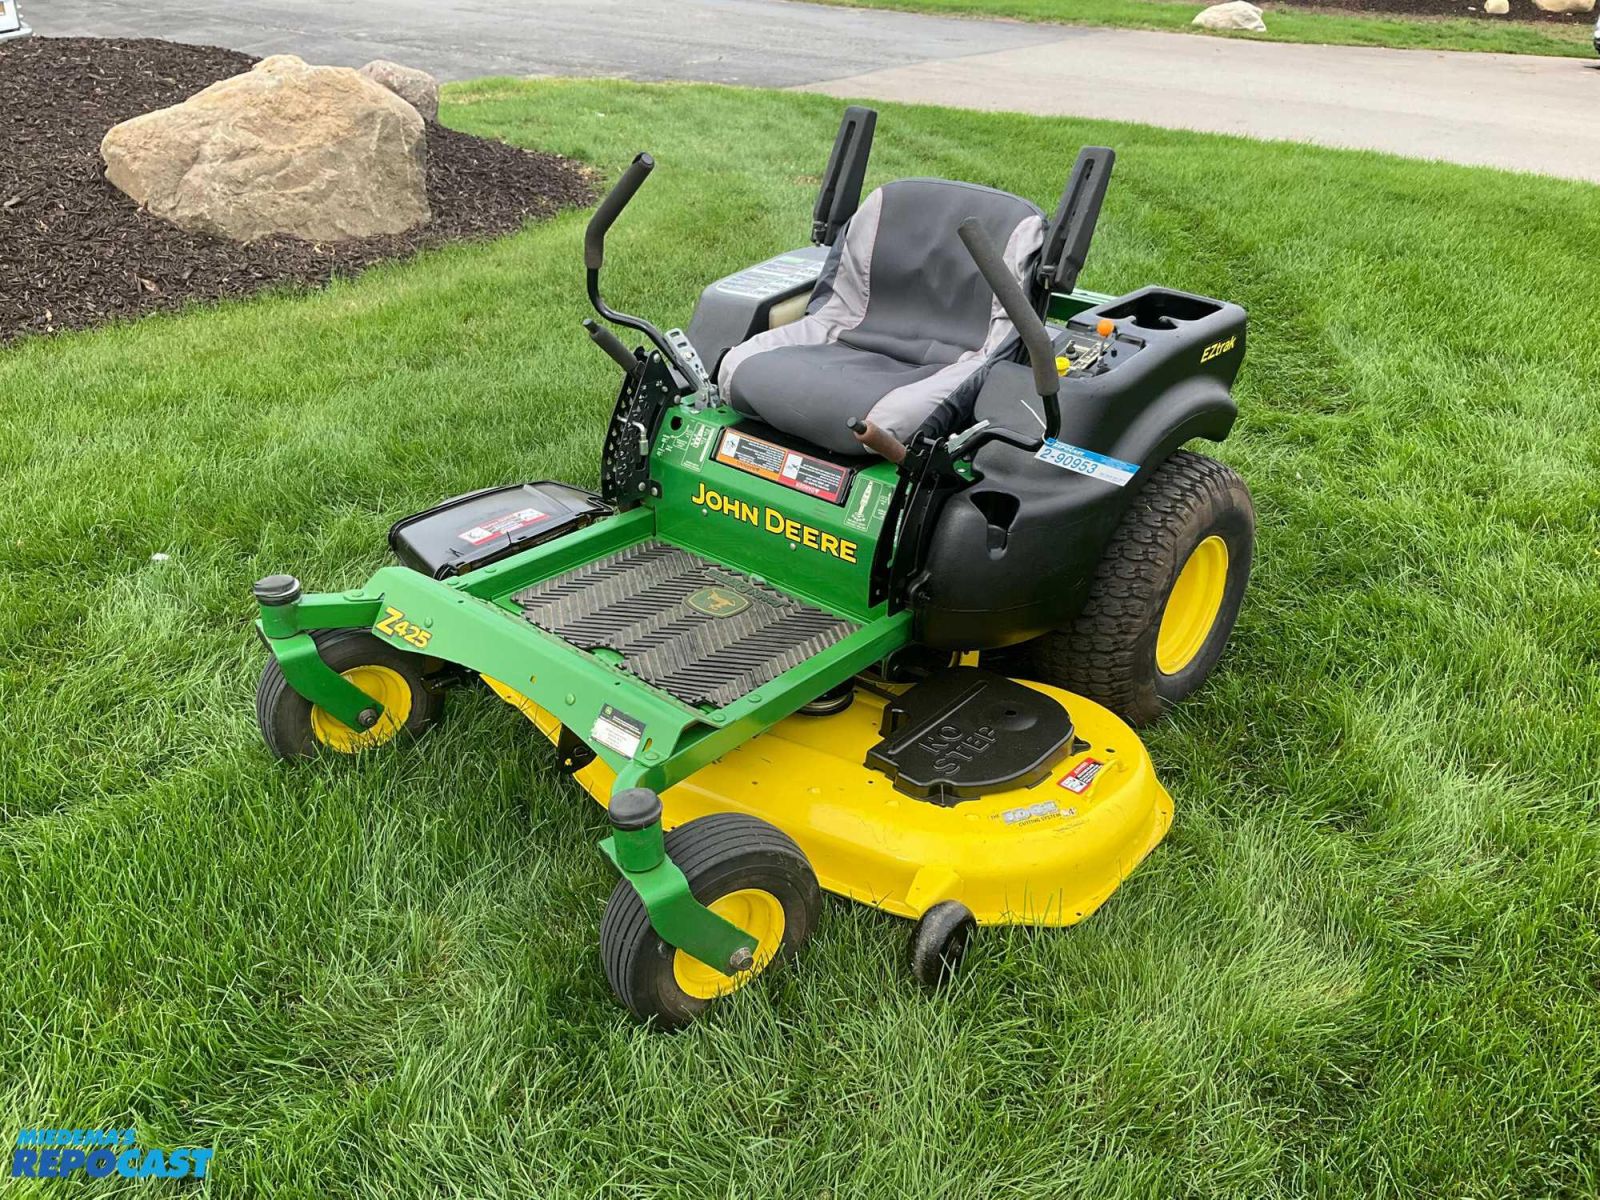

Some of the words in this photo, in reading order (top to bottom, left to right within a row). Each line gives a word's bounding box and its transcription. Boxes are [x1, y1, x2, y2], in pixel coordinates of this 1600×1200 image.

[1200, 335, 1237, 363] EZtrak
[1040, 448, 1098, 474] 2-90953
[691, 482, 759, 527] JOHN
[765, 506, 858, 564] DEERE
[375, 606, 432, 649] Z425
[918, 726, 963, 753] NO
[933, 726, 996, 777] STEP
